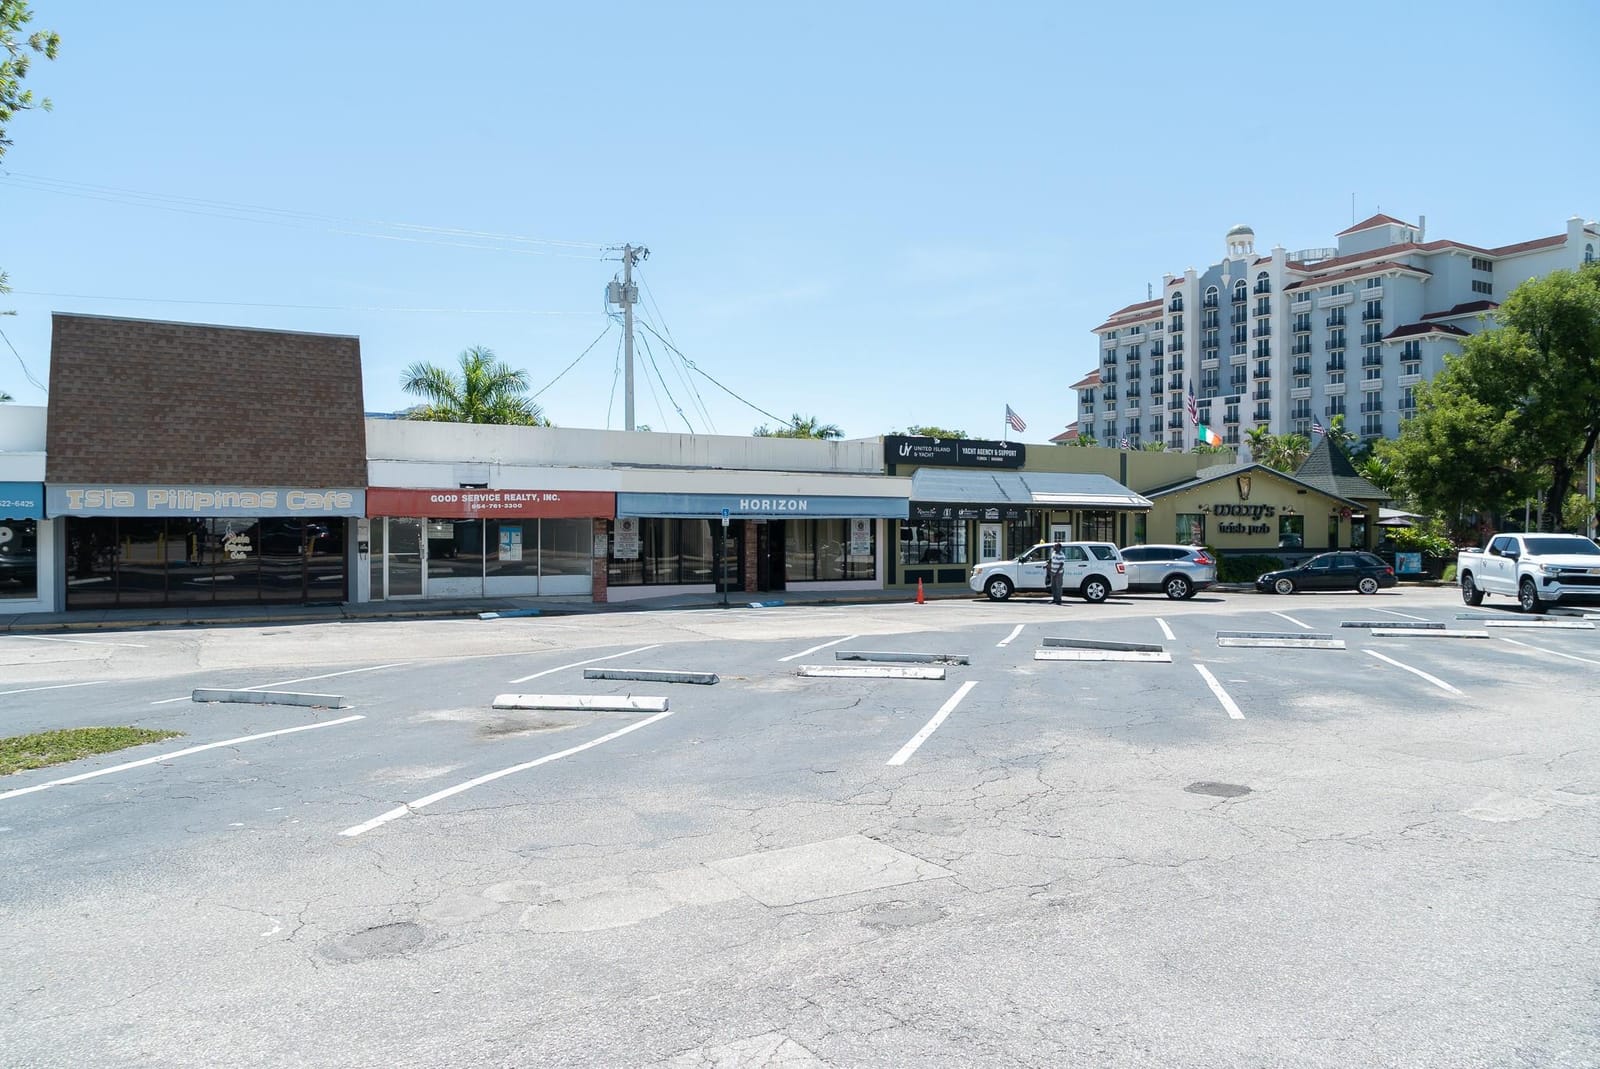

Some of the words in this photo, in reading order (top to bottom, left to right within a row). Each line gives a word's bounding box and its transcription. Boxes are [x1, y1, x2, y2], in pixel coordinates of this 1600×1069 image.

[962, 447, 977, 455] YACHT
[977, 448, 994, 456] AGENCY
[998, 449, 1017, 457] SUPPORT
[66, 489, 135, 509] Isla
[147, 489, 277, 511] Pilipinas
[286, 491, 353, 511] Cafe
[430, 494, 458, 503] GOOD
[461, 493, 500, 502] SERVICE
[504, 493, 540, 502] REALTY,
[740, 499, 808, 510] HORIZON
